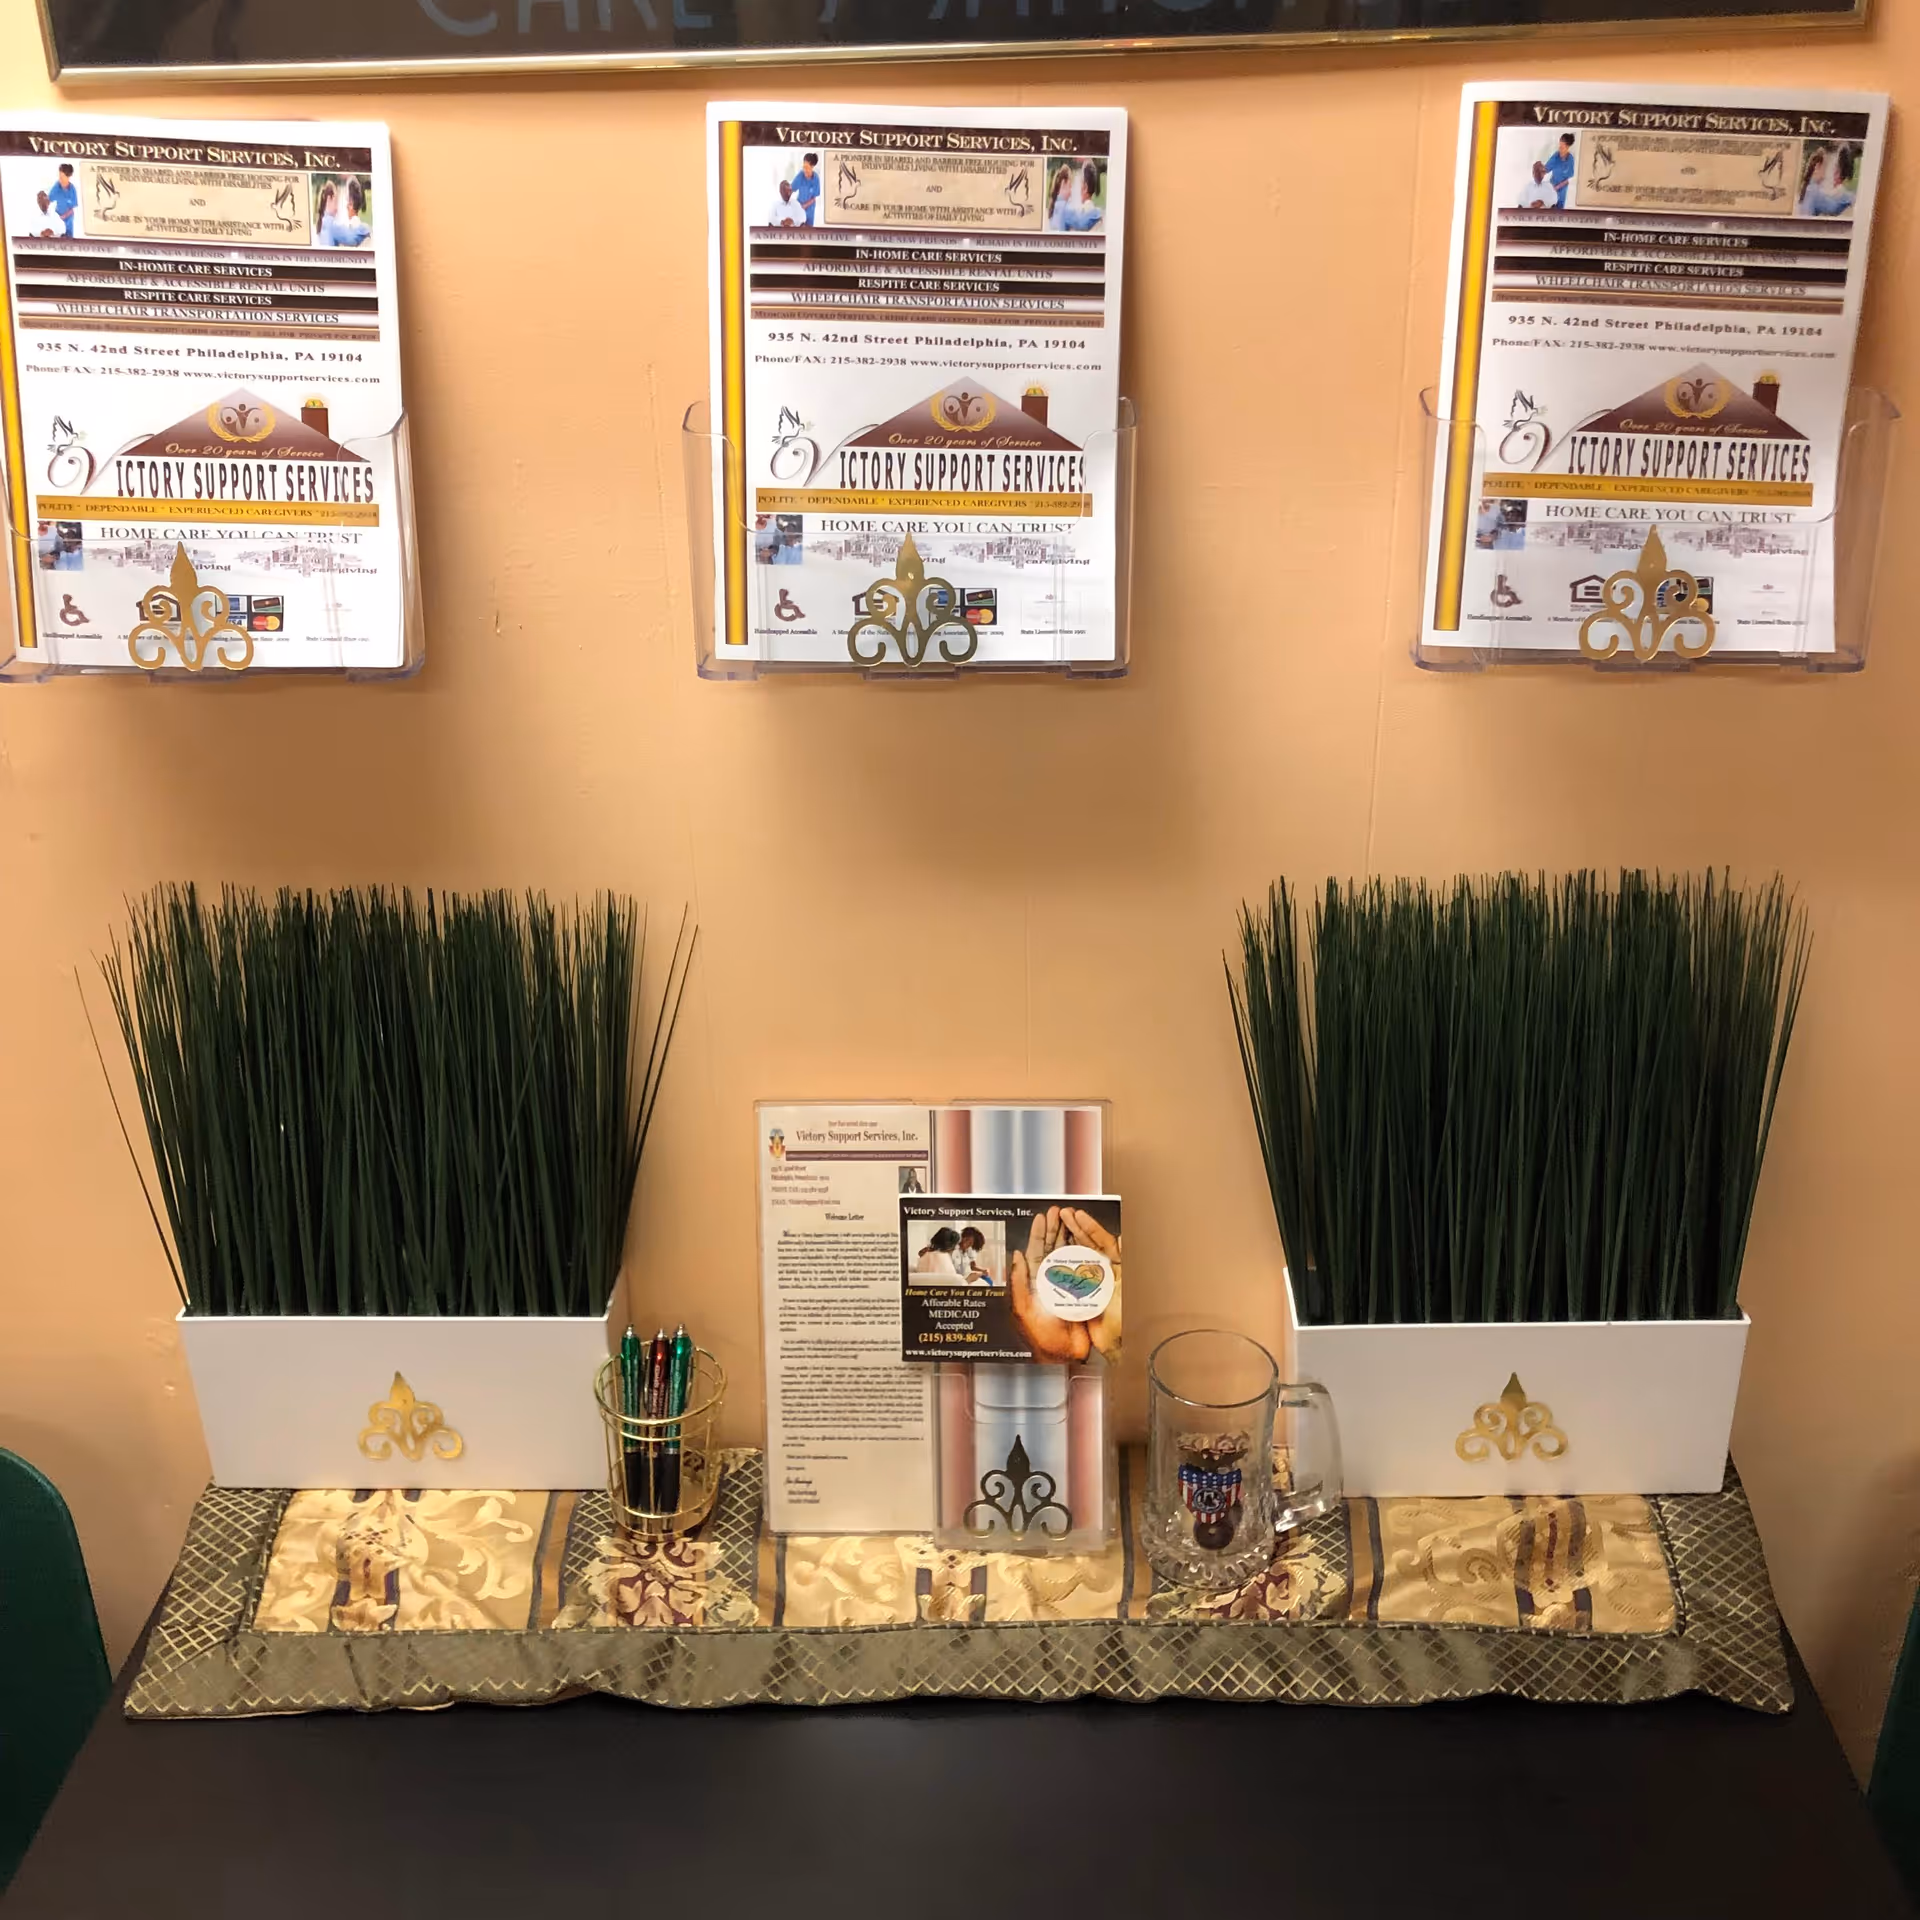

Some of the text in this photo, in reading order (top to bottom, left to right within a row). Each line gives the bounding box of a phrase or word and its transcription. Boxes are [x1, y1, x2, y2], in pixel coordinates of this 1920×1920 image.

[1534, 106, 1836, 135] VICTORY SUPPORT SERVICES, INC.
[776, 126, 1078, 152] VICTORY SUPPORT SERVICES, INC.
[28, 136, 341, 169] VICTORY SUPPORT SERVICES, INC.
[1604, 232, 1748, 248] IN-HOME CARE SERVICES
[856, 249, 1002, 263] IN-HOME CARE SERVICES
[120, 260, 272, 278] IN-HOME CARE SERVICES
[803, 262, 881, 274] AFFORDABLE
[968, 268, 1016, 278] RENTAL
[1018, 269, 1052, 279] UNITS
[1604, 262, 1744, 278] RESPITE CARE SERVICES
[858, 279, 1000, 292] RESPITE CARE SERVICES
[124, 290, 272, 306] RESPITE CARE SERVICES
[790, 292, 1065, 310] WHEELCHAIR TRANSPORTATION SERVICES
[56, 303, 339, 324] WHEELCHAIR TRANSPORTATION SERVICES
[1508, 316, 1535, 325] 935
[1541, 316, 1557, 326] N.
[1563, 317, 1599, 328] 42nd
[1604, 318, 1648, 330] Street
[1655, 320, 1751, 335] Philadelphia,
[1756, 324, 1776, 335] PA
[768, 332, 1085, 349] 935 N. 42nd Street Philadelphia, PA 19104
[38, 342, 362, 362] 935 N. 42nd Street Philadelphia, PA 19104
[754, 354, 1102, 370] Phone/FAX: 215-382-2938 www.victorysupportservices.com
[101, 368, 180, 378] 215-382-2938
[183, 371, 380, 384] www.victorysupportservices.com
[888, 433, 1042, 448] Over 20 years of Service
[1641, 436, 1722, 479] SUPPORT
[1726, 442, 1810, 482] SERVICES
[914, 452, 995, 492] SUPPORT
[1002, 454, 1086, 493] SERVICES
[194, 460, 277, 501] SUPPORT
[286, 464, 374, 504] SERVICES
[808, 496, 879, 505] DEPENDABLE
[888, 498, 960, 507] EXPERIENCED
[963, 499, 1026, 508] CAREGIVERS
[86, 504, 157, 514] DEPENDABLE
[169, 507, 243, 517] EXPERIENCED
[246, 510, 312, 518] CAREGIVERS
[1546, 505, 1796, 524] HOME CARE YOU CAN TRUST
[101, 527, 158, 539] HOME
[164, 528, 209, 540] CARE
[822, 520, 877, 532] HOME
[882, 520, 928, 532] CARE
[933, 522, 971, 533] YOU
[976, 522, 1012, 534] CAN
[796, 1130, 918, 1144] Victory Support Services, Inc.
[904, 1206, 1034, 1217] Victory Support Services, Inc.
[905, 1288, 927, 1296] Home
[985, 1289, 1004, 1297] Trust
[963, 1300, 986, 1308] Rates
[928, 1310, 980, 1318] MEDICAID
[935, 1322, 974, 1330] Accepted
[918, 1333, 988, 1344] (215) 839-8671
[906, 1348, 1032, 1358] www.victorysupportservices.com
